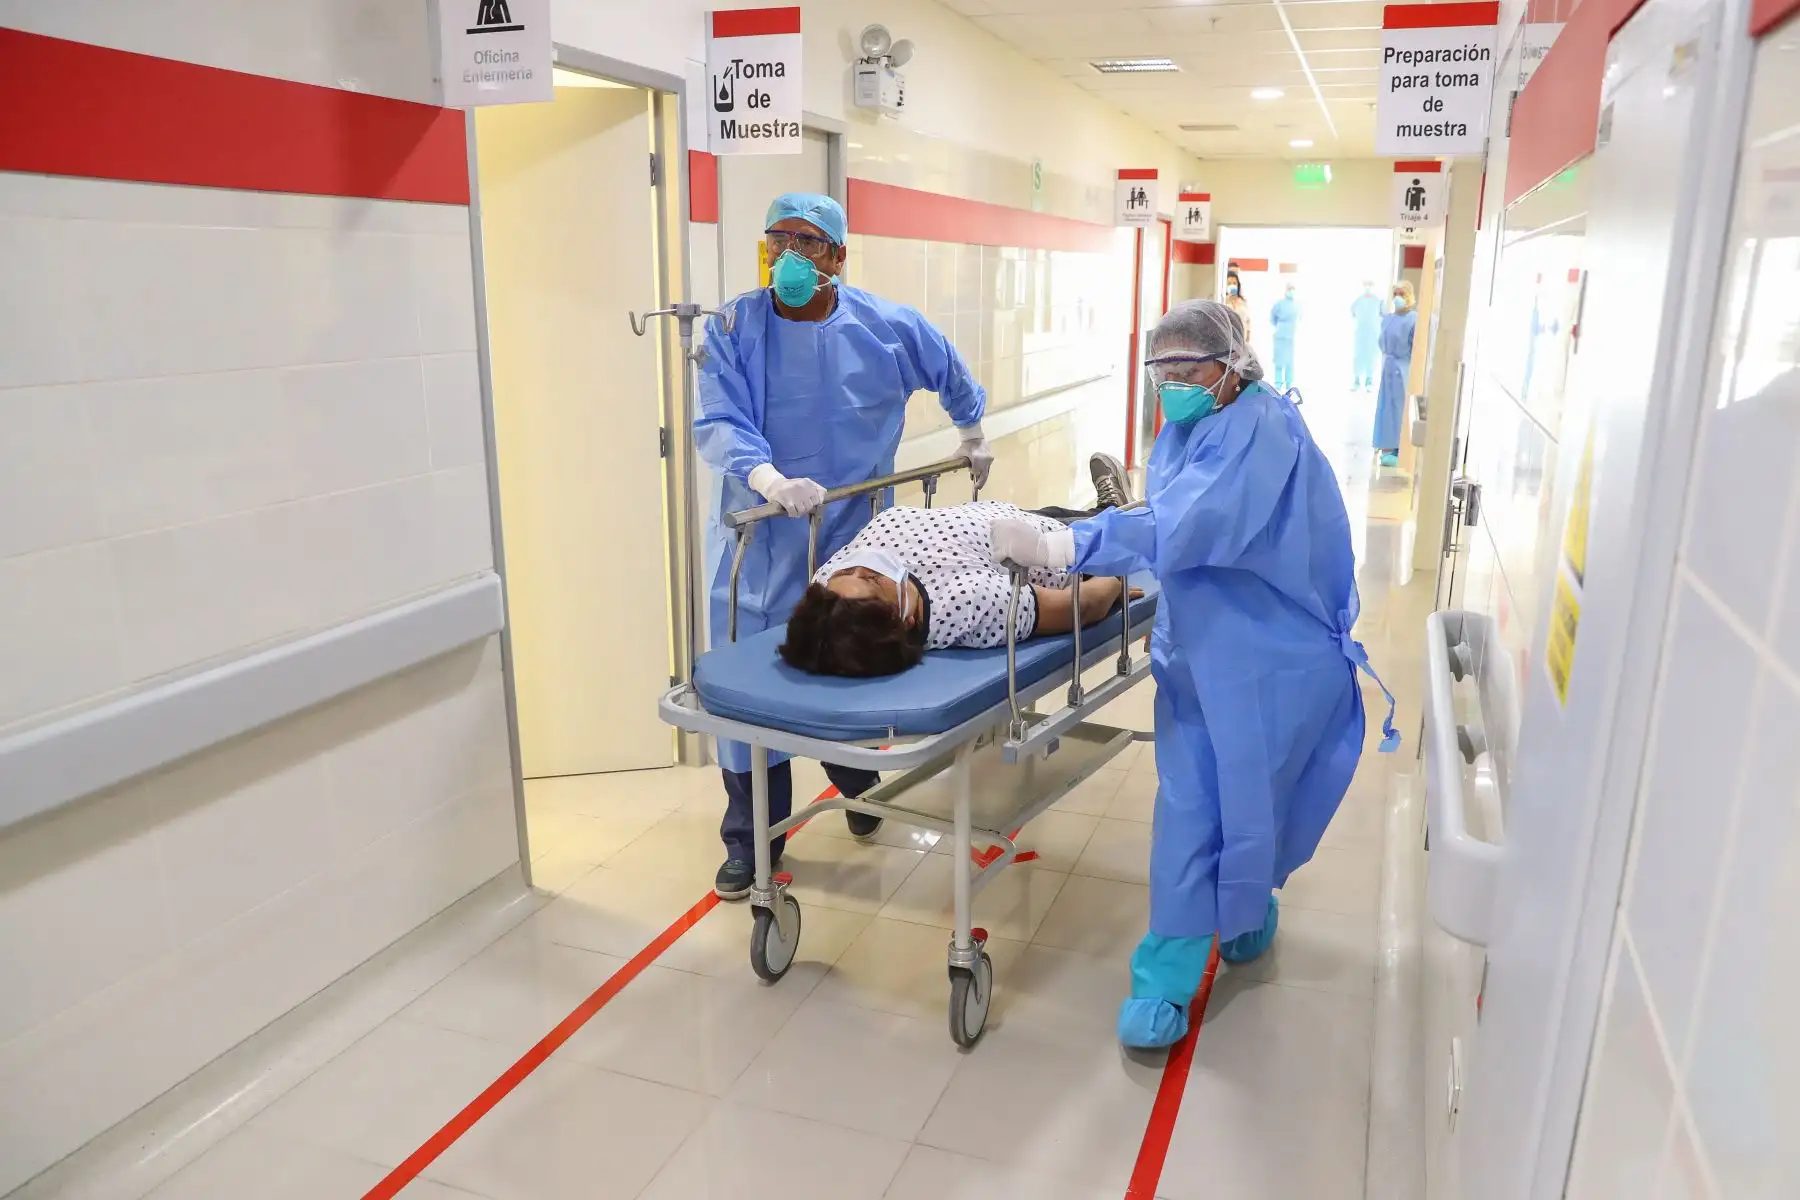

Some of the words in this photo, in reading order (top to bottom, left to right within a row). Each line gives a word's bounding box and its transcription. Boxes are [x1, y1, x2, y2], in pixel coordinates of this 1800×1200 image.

[473, 49, 520, 65] Oficina
[1383, 43, 1491, 67] Preparación
[731, 59, 786, 79] Toma
[1391, 74, 1429, 92] para
[1435, 72, 1479, 88] toma
[747, 89, 771, 109] de
[1422, 96, 1444, 113] de
[720, 118, 800, 139] Muestra
[1396, 121, 1467, 137] muestra
